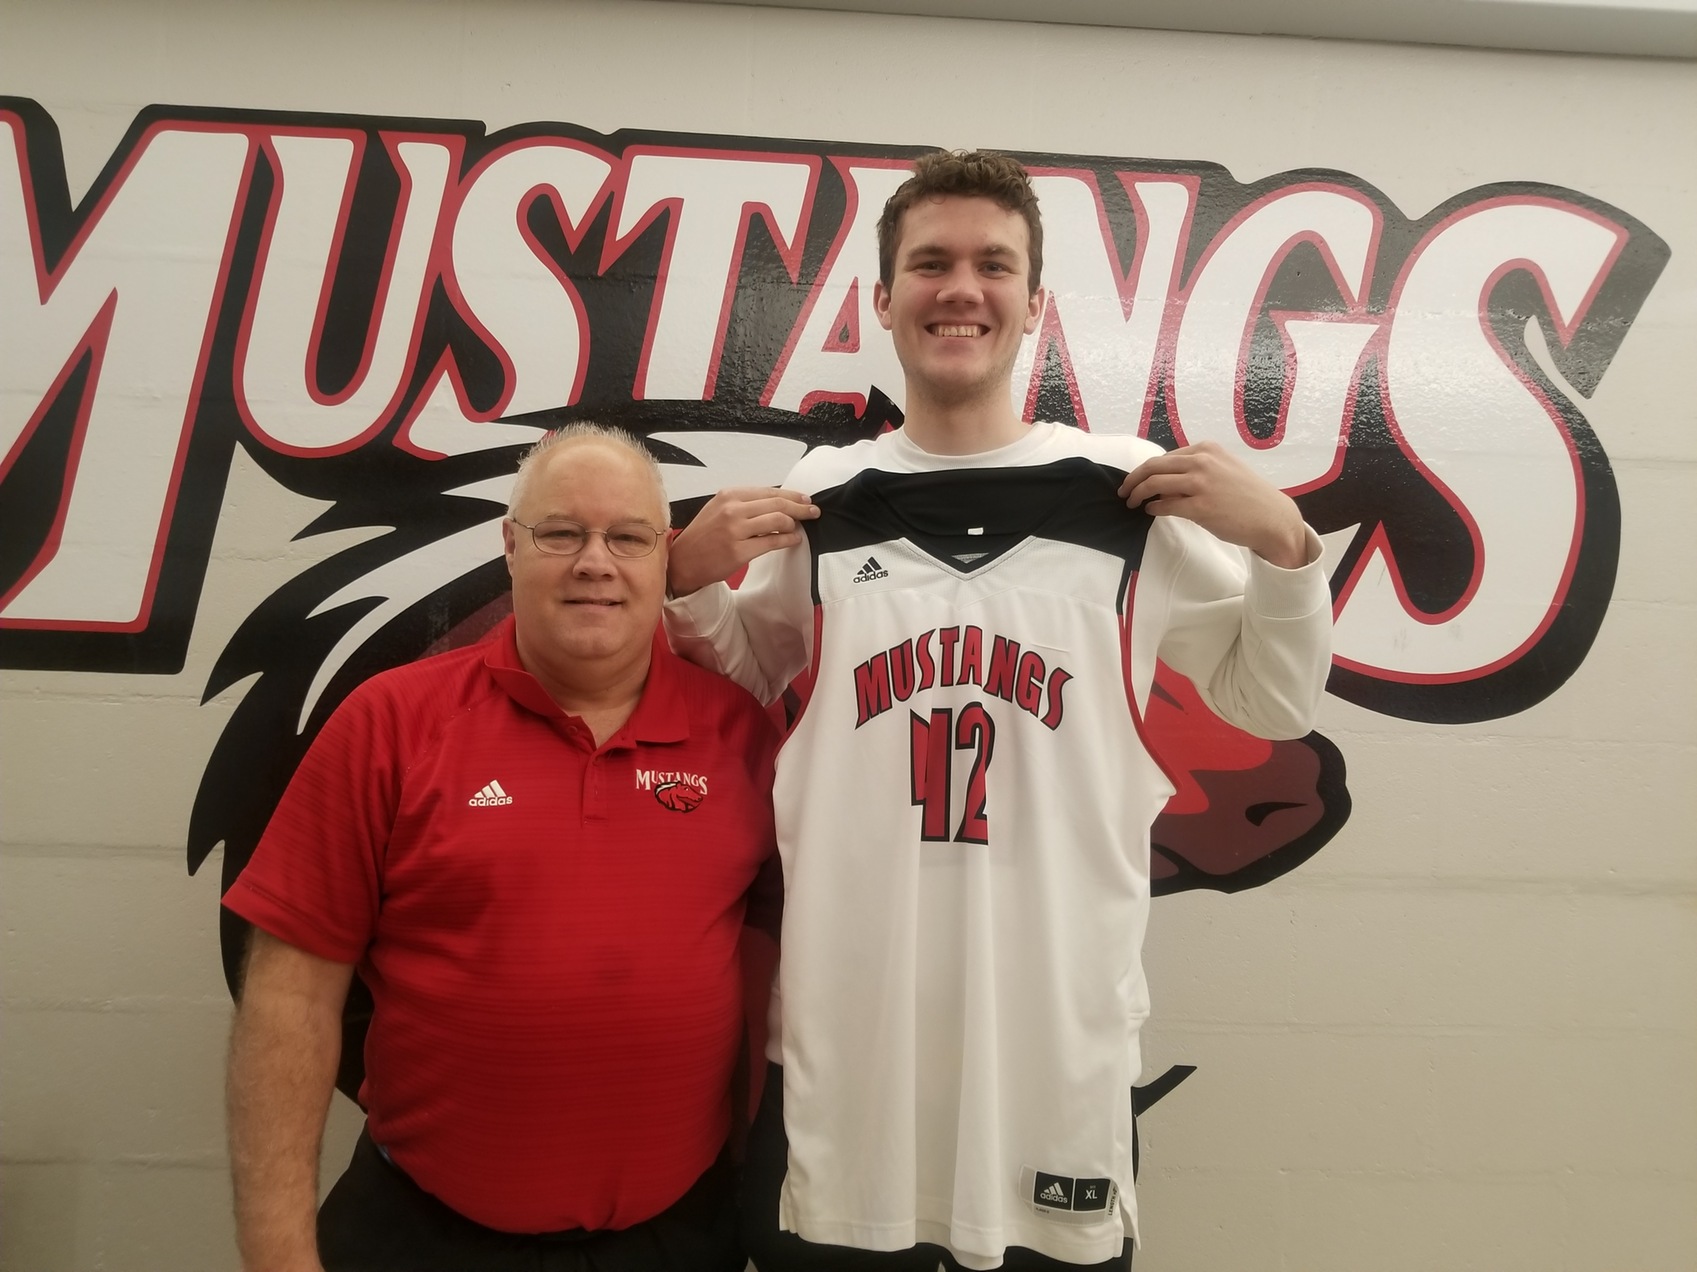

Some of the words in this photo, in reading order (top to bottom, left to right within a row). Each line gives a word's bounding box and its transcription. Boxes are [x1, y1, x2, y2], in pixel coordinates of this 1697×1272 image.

[853, 569, 889, 584] adidas
[853, 624, 1074, 732] MUSTANGS
[909, 701, 996, 846] 42
[635, 768, 708, 795] MUSTANGS
[468, 794, 513, 807] adidas
[1040, 1193, 1068, 1204] adidas
[1085, 1189, 1098, 1200] XL
